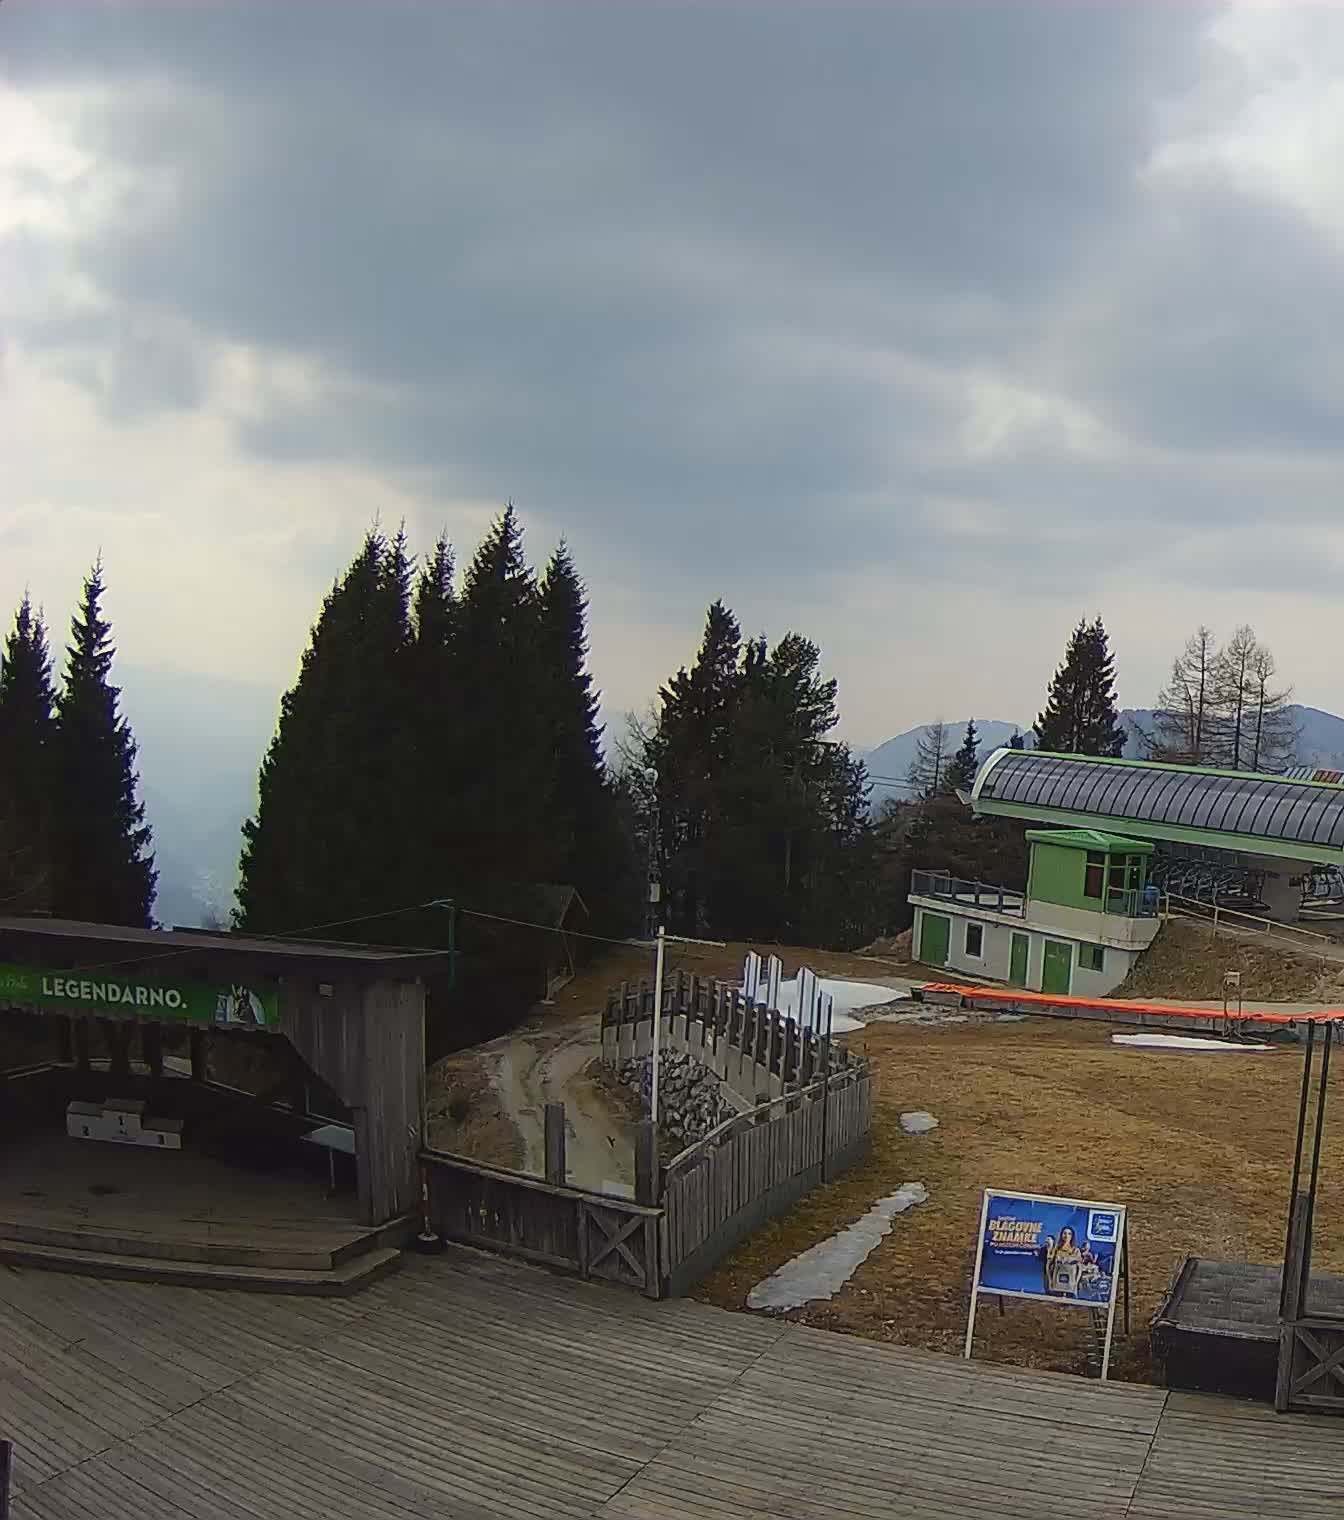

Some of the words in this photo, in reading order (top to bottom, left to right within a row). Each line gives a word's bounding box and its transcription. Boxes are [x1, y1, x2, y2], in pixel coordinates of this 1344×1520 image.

[41, 977, 188, 1009] LEGENDARNO.
[989, 1219, 1043, 1233] BLAGOVNE
[991, 1231, 1039, 1243] ZNAMKE
